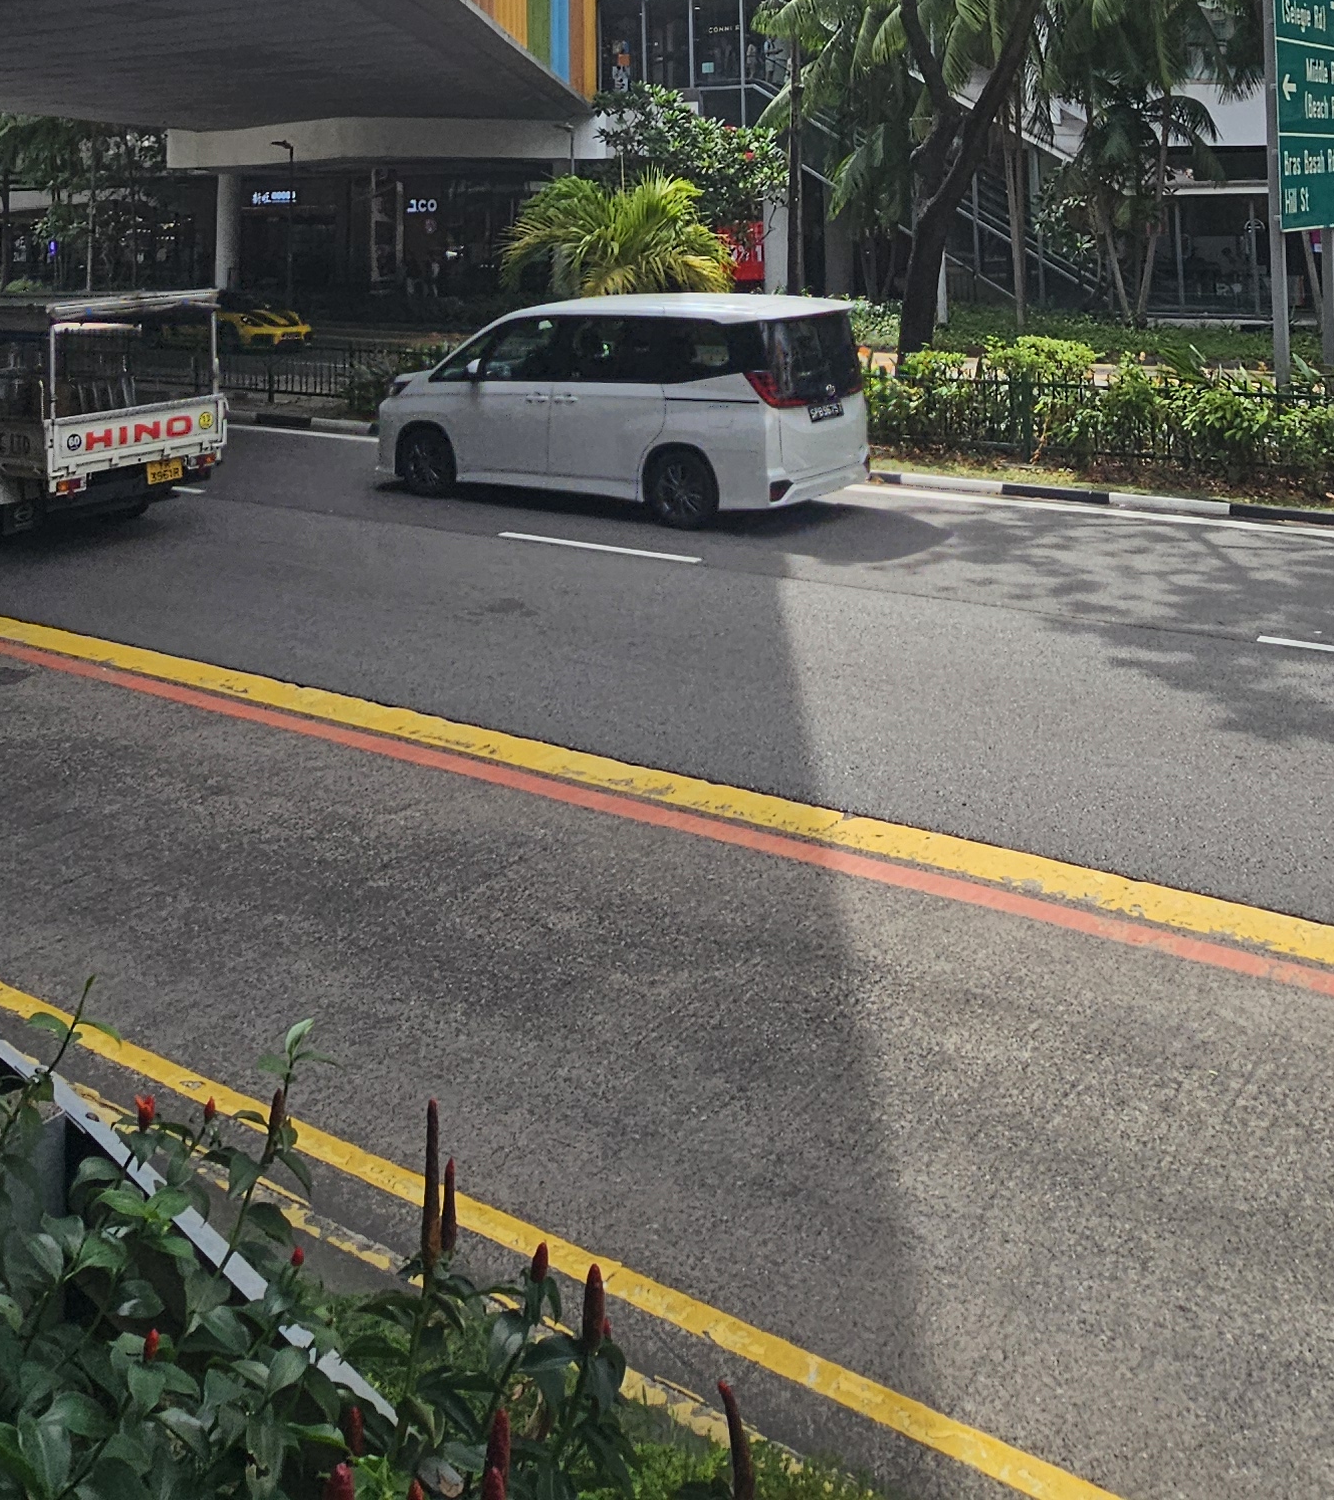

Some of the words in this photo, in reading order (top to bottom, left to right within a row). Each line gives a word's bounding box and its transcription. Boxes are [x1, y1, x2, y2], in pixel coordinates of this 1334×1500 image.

[1313, 5, 1326, 32] Rd)
[1305, 58, 1329, 84] Middle
[1304, 94, 1329, 119] (Beach
[1284, 151, 1301, 176] Bras
[1304, 150, 1325, 174] Basah
[1285, 189, 1298, 214] Hill
[1300, 188, 1310, 212] St
[69, 436, 80, 446] 60
[85, 416, 193, 452] HINO
